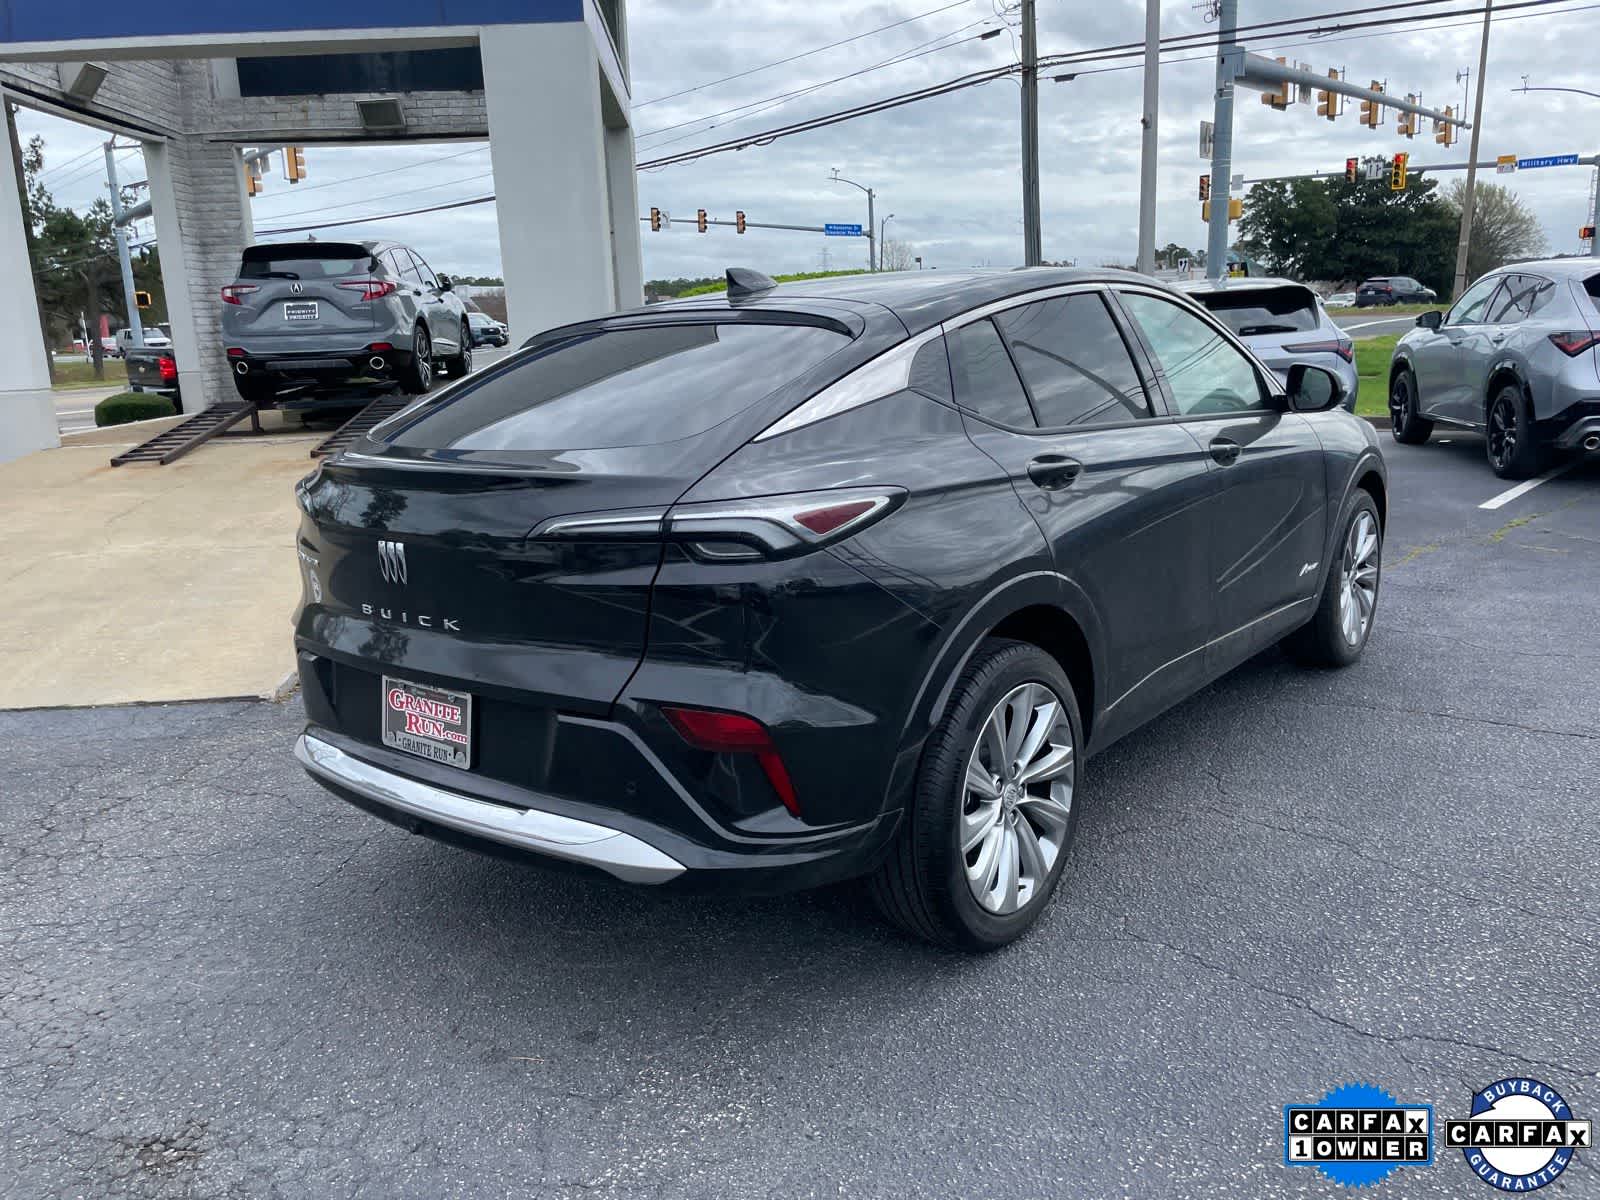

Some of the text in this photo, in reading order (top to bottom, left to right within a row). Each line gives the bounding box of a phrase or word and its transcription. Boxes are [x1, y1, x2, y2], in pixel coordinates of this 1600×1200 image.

[1521, 157, 1575, 167] Military Hwy
[361, 603, 460, 631] BUICK
[402, 737, 448, 761] GRANITE RUN
